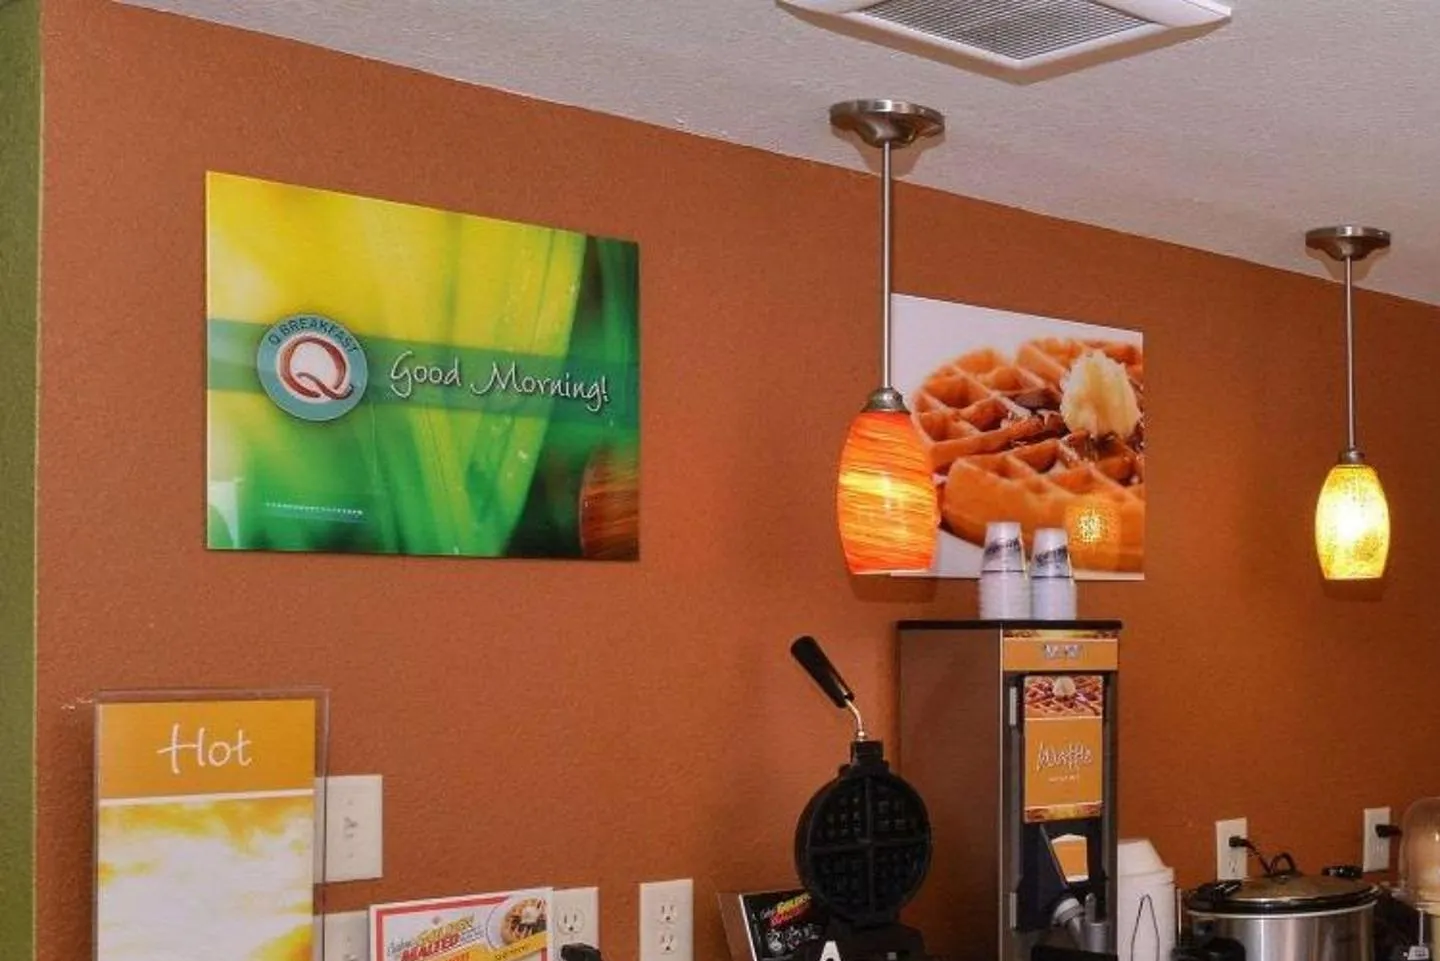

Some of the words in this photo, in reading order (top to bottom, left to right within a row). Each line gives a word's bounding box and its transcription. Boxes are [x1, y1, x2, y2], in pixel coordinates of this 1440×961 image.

[280, 318, 358, 353] BREAKFAST
[390, 350, 462, 399] Good
[469, 360, 609, 412] Morning!
[155, 722, 252, 774] Hot
